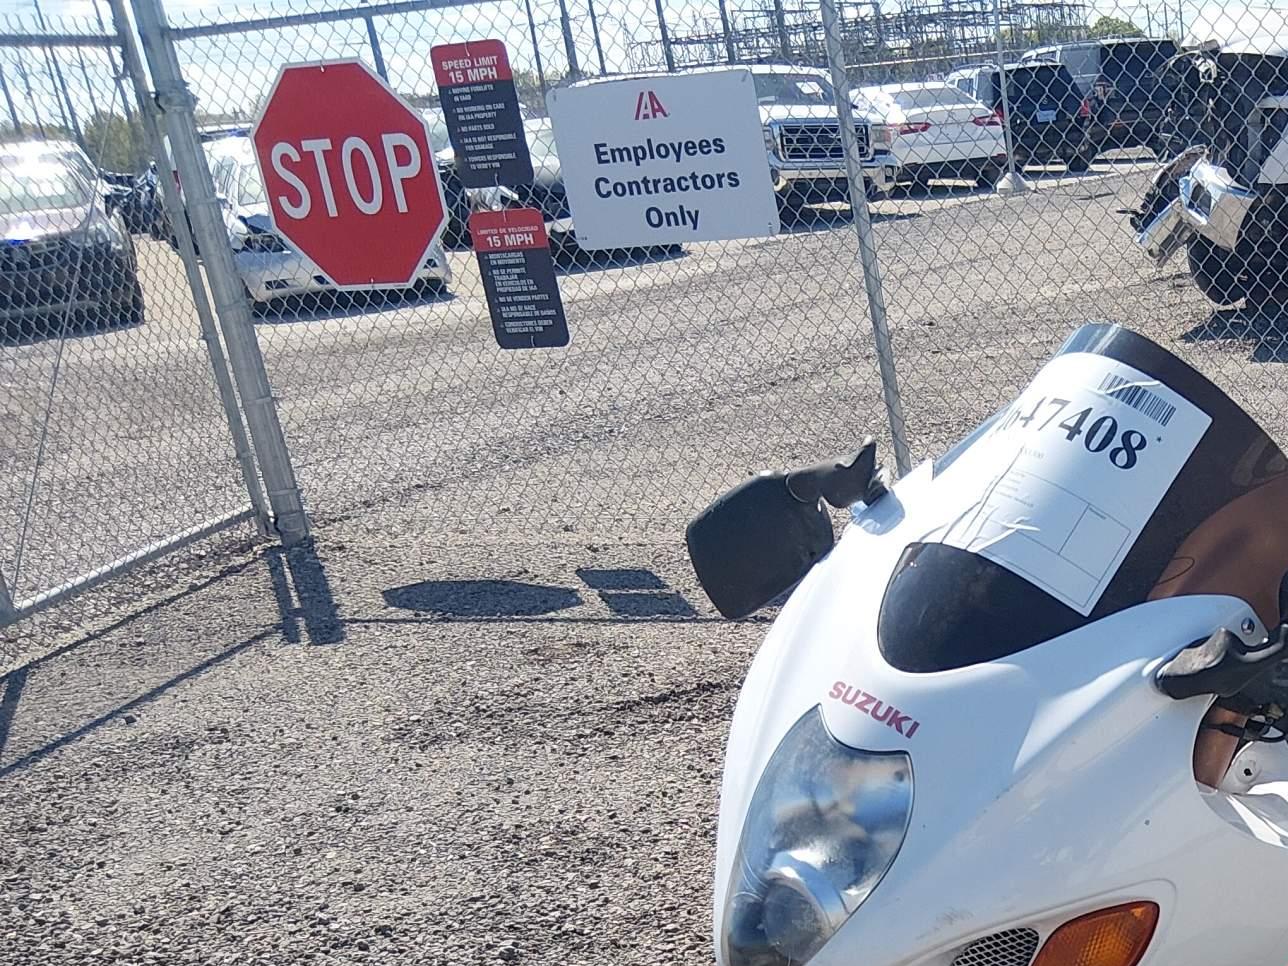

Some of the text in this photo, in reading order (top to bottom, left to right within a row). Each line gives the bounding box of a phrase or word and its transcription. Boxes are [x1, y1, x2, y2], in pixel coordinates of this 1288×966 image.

[442, 56, 498, 70] SPEED LIMIT
[448, 66, 498, 84] 15 MPH
[594, 137, 726, 166] Employees
[272, 132, 422, 220] STOP
[594, 170, 740, 198] Contractors
[646, 205, 700, 230] Only
[486, 233, 534, 247] 15 MPH
[828, 680, 920, 739] SUZUKI
